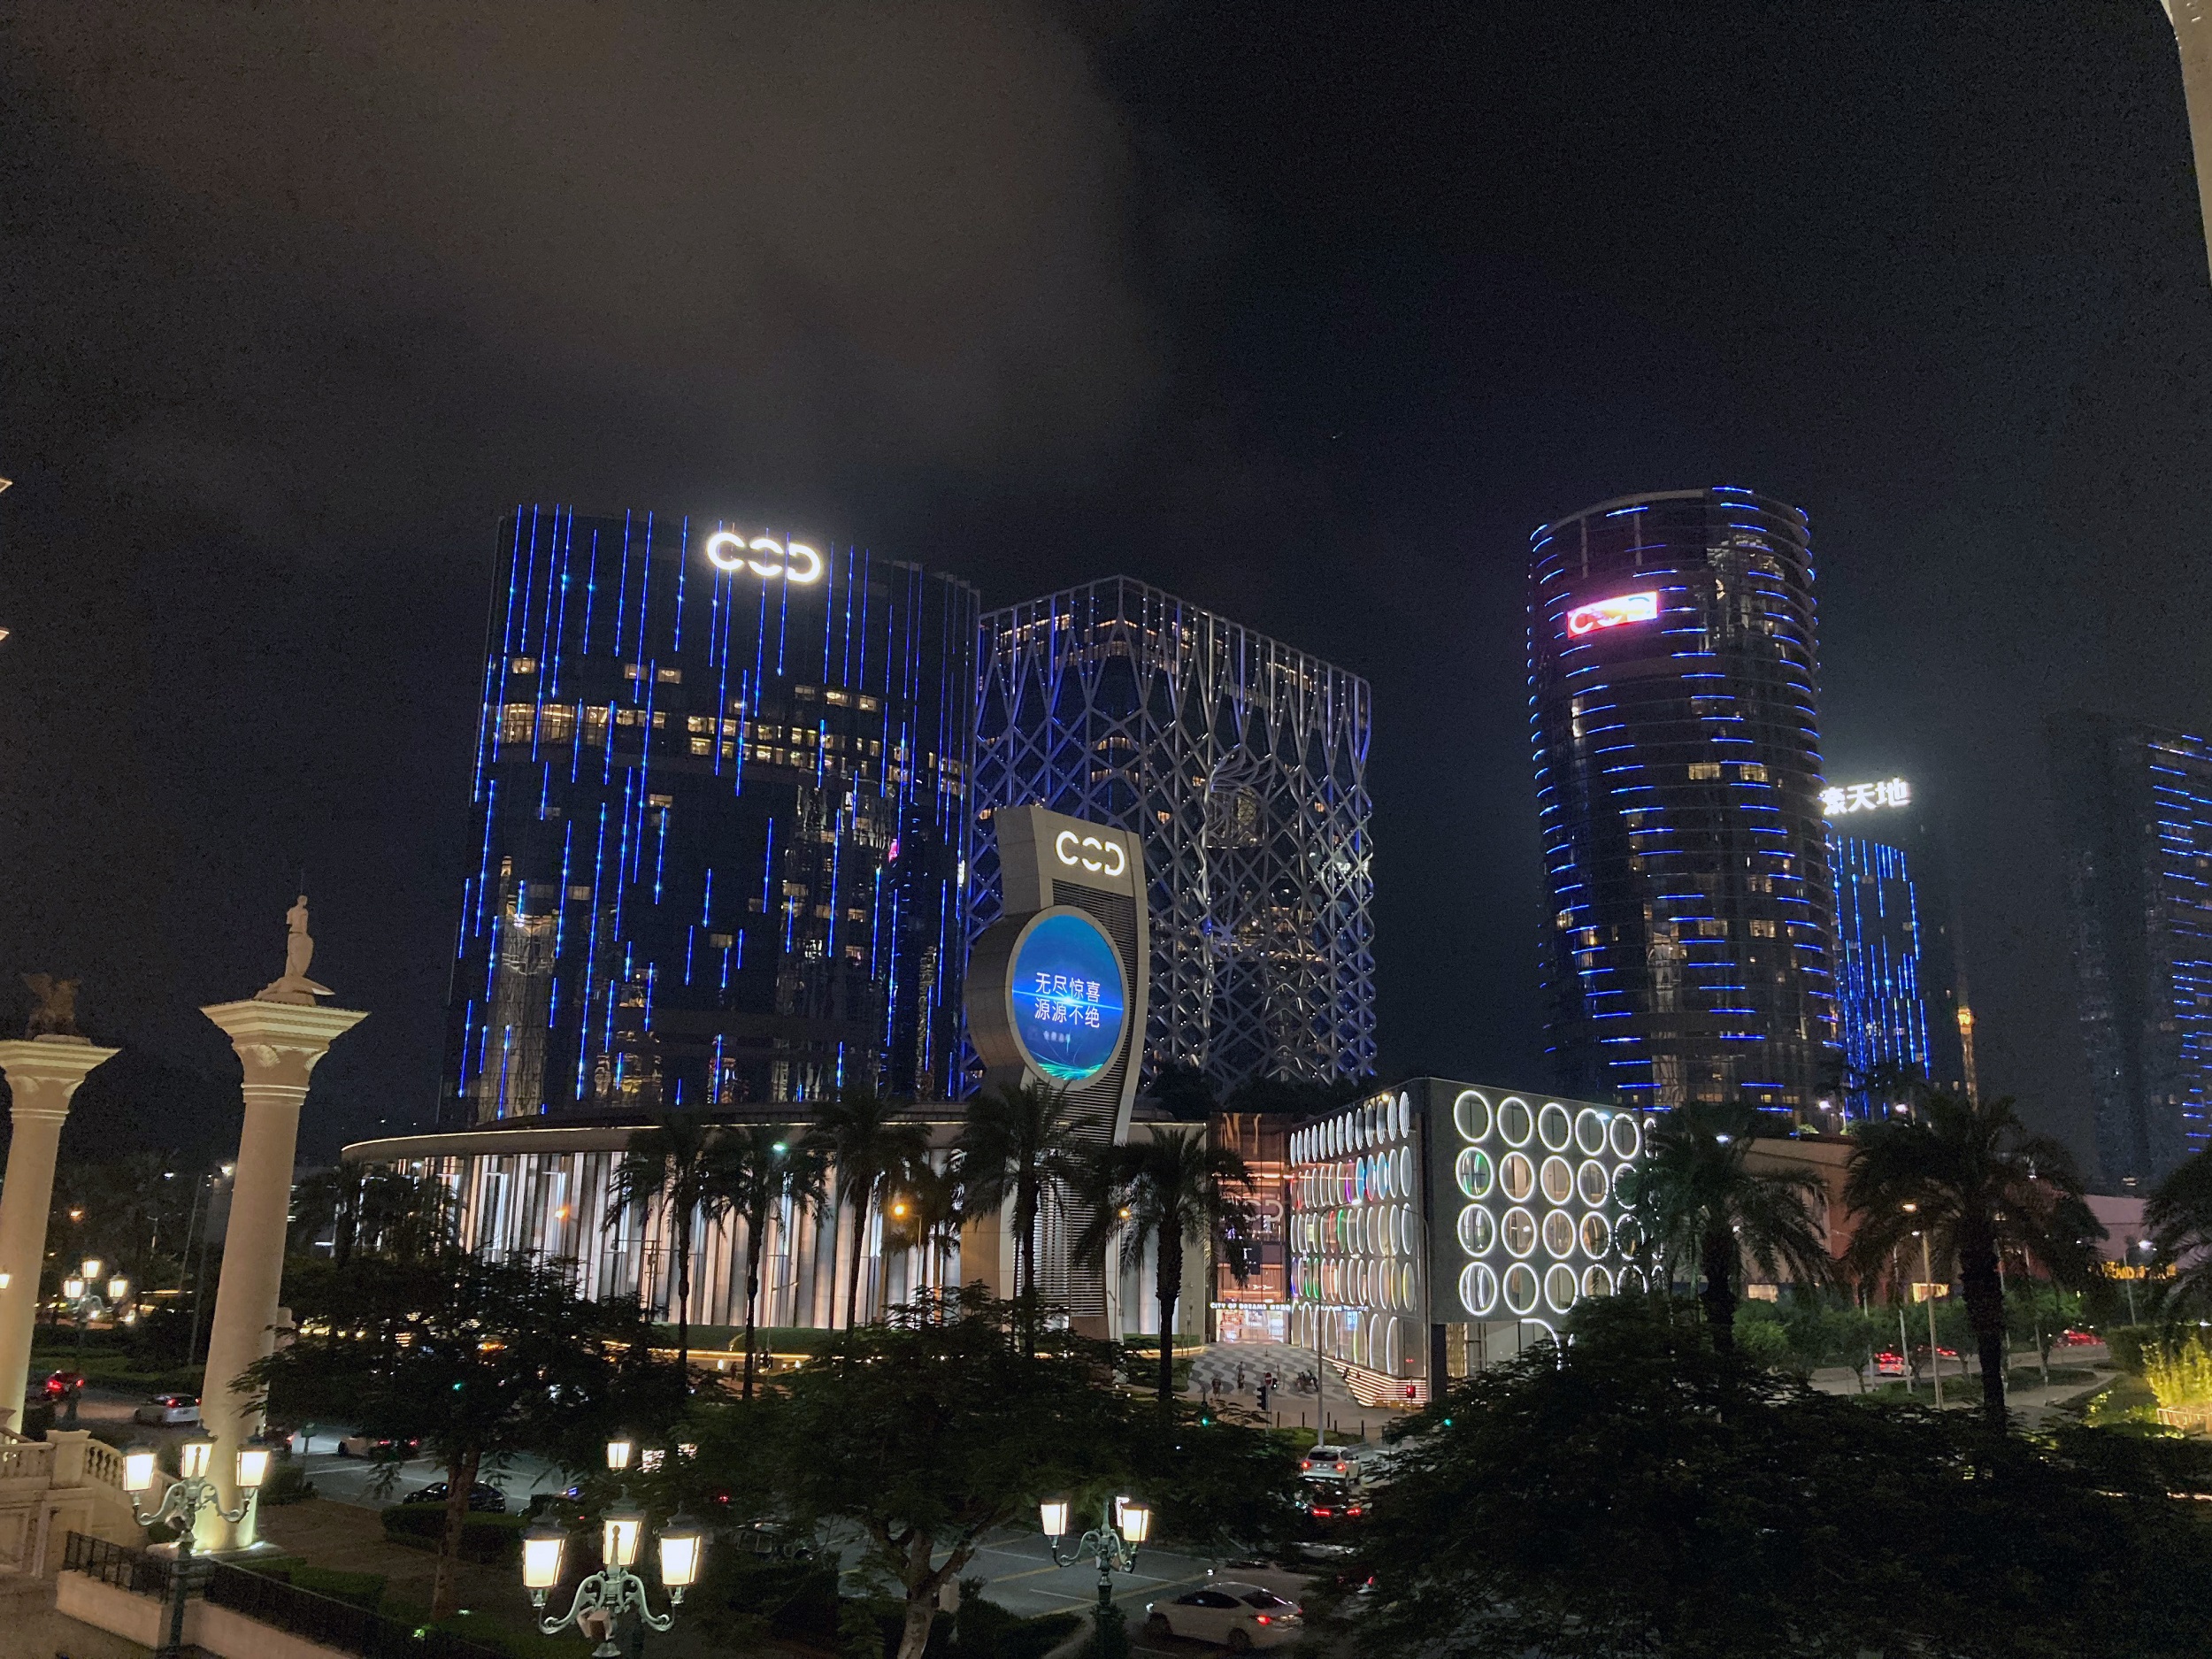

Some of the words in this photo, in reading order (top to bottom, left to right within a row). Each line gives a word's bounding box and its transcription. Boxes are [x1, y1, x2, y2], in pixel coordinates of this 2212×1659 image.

[1035, 972, 1101, 1002] 无尽惊喜
[1034, 997, 1100, 1028] 源源不绝
